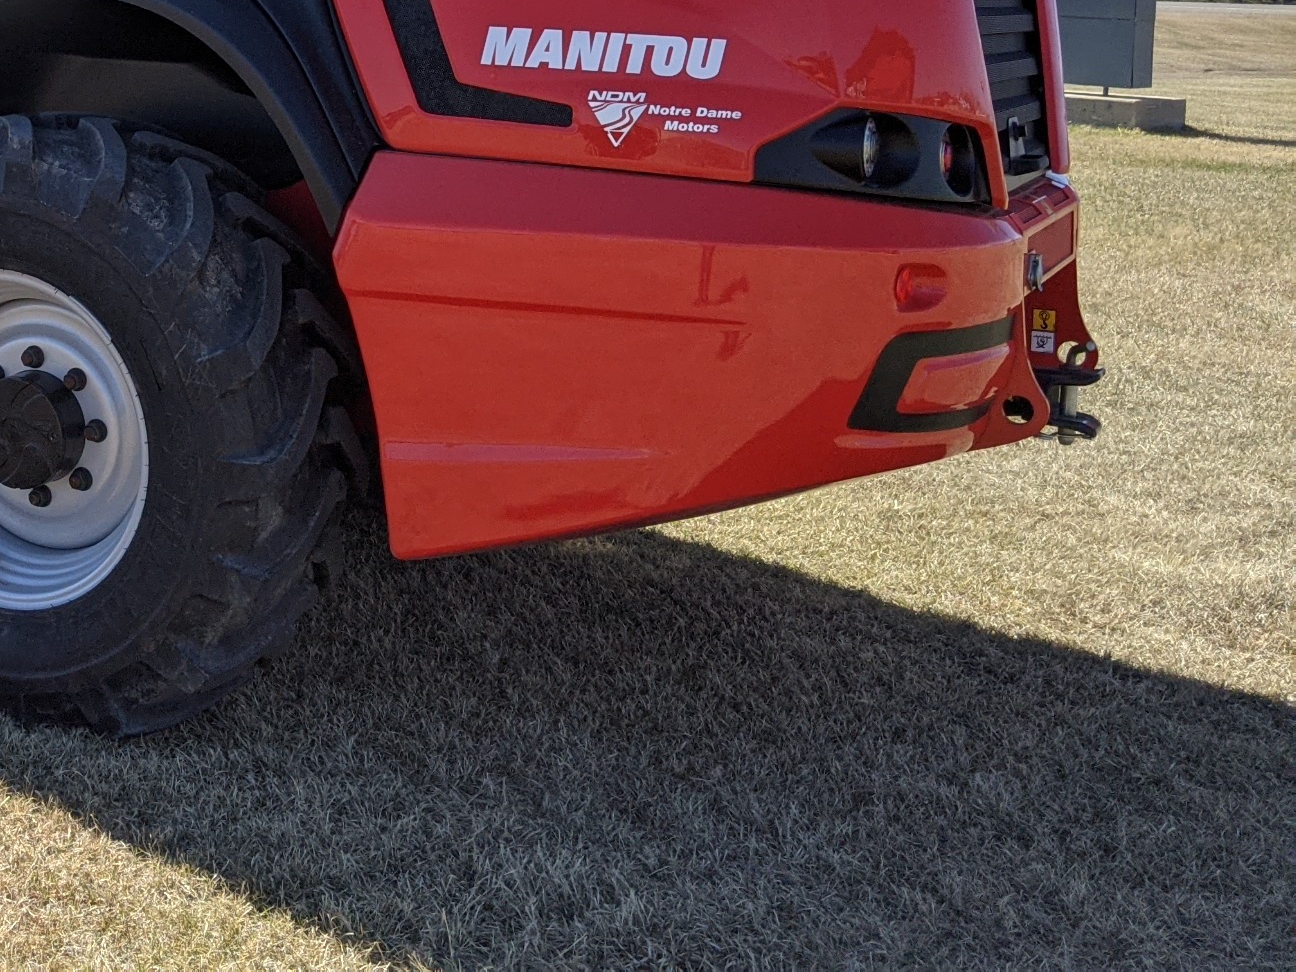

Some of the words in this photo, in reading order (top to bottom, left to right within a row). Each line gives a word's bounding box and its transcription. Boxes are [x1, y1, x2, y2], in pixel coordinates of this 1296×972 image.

[480, 26, 727, 80] MANITOU
[588, 90, 647, 103] NDM
[648, 104, 692, 117] Notre
[696, 107, 742, 120] Dame
[664, 120, 719, 134] Motors
